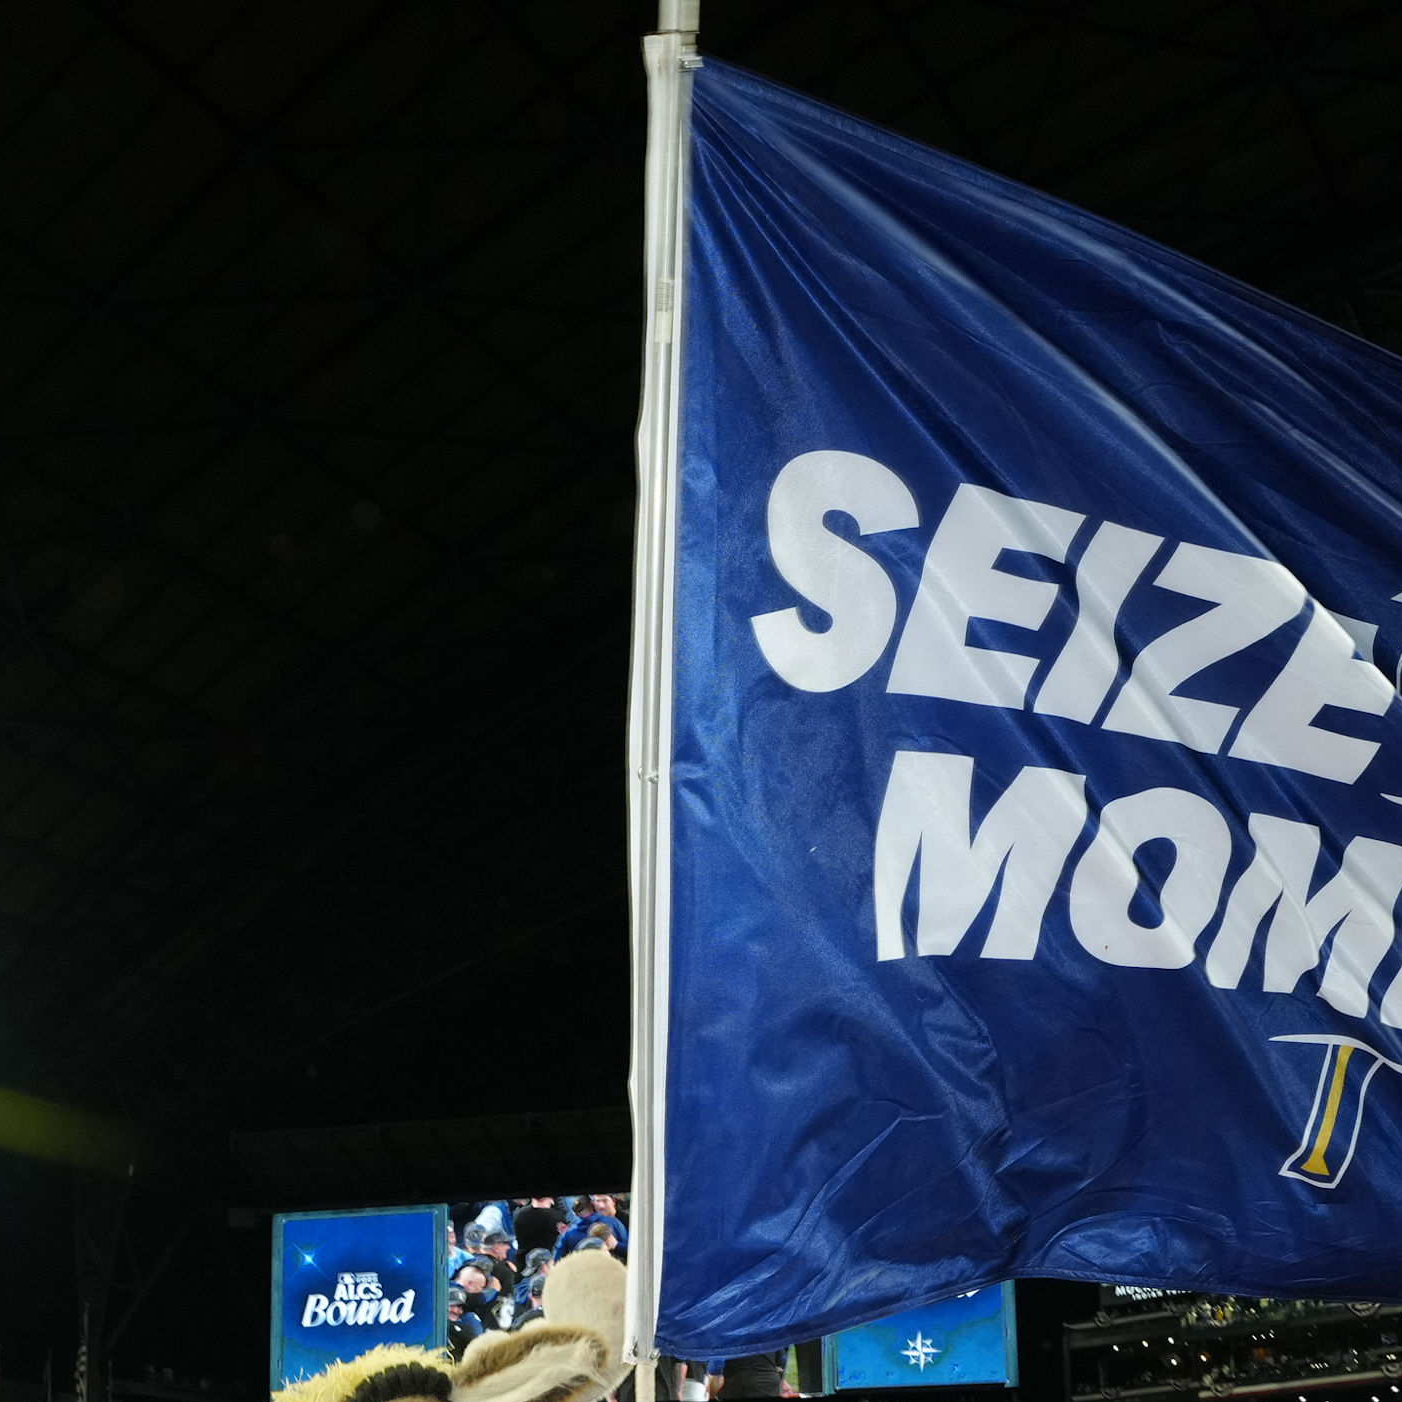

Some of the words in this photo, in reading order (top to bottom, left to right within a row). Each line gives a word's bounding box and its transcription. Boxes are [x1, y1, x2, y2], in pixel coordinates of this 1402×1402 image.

[751, 449, 1398, 785] SEIZE
[301, 1288, 416, 1328] Bound
[334, 1282, 384, 1301] ALCS
